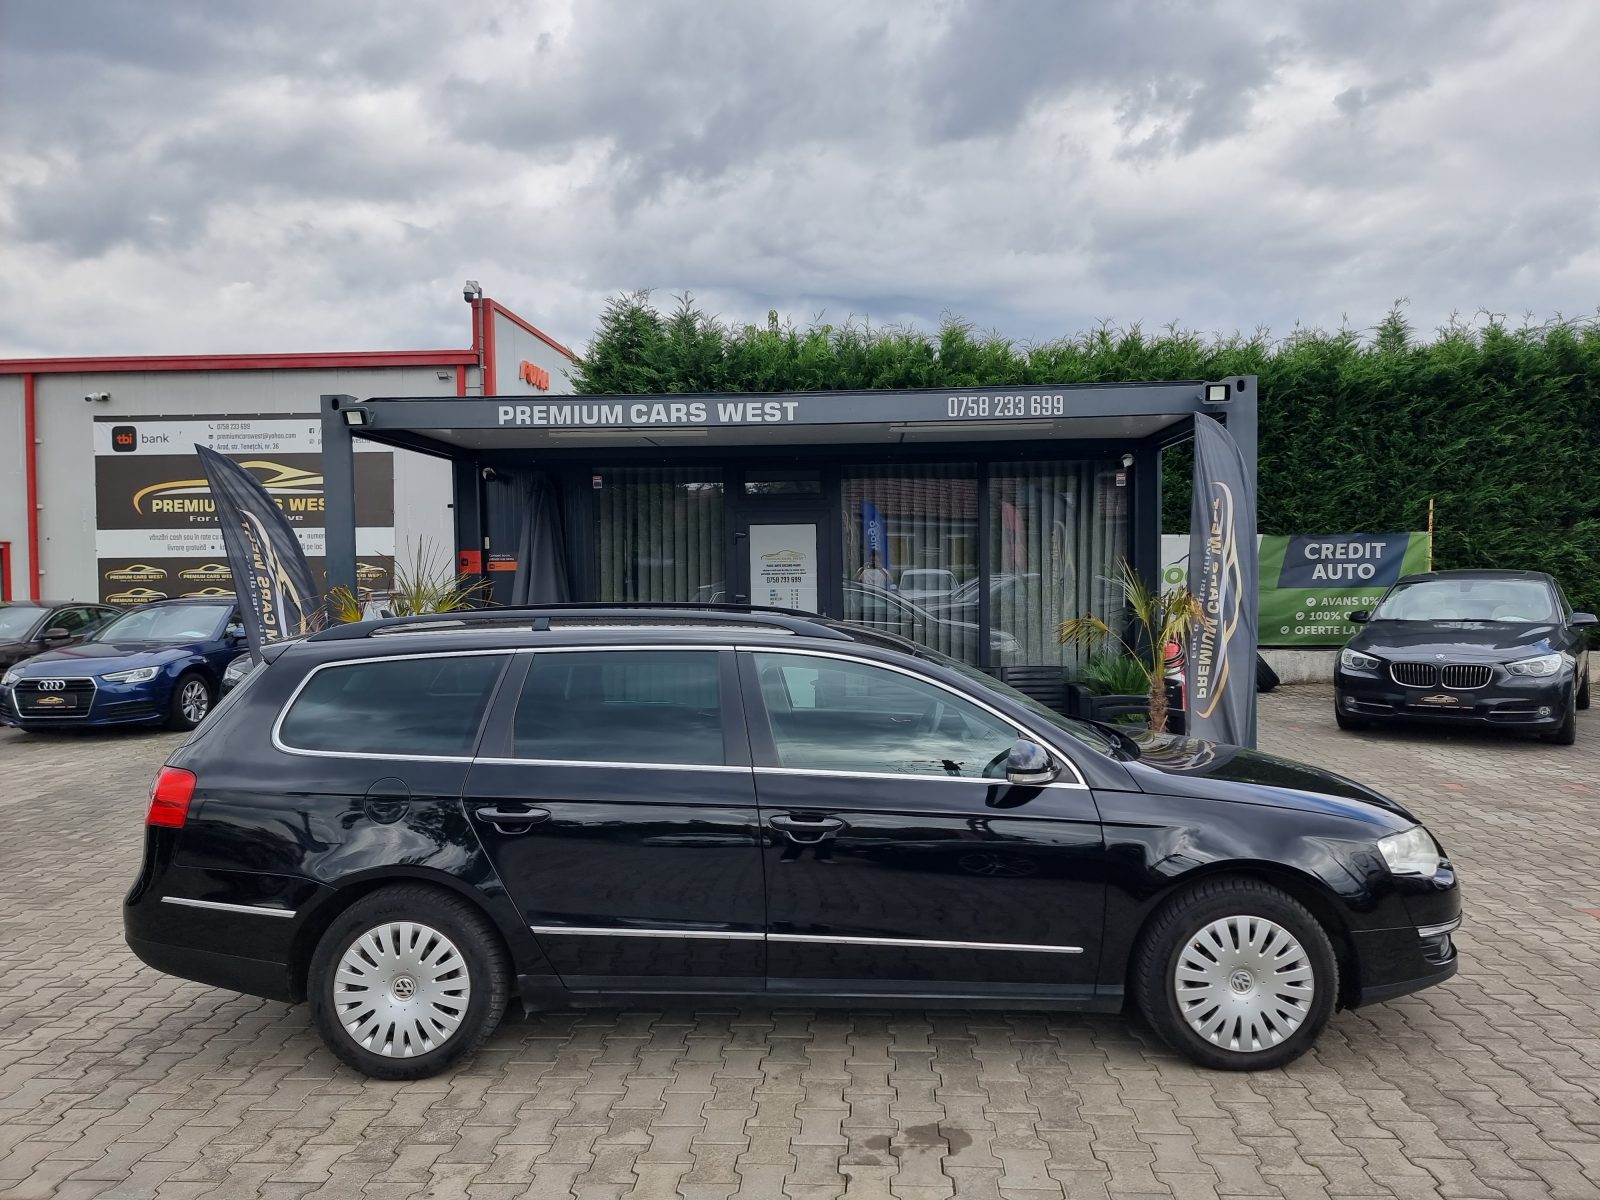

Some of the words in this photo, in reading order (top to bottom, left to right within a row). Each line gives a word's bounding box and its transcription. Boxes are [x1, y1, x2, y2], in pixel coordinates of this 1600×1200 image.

[948, 397, 989, 417] 0758
[994, 396, 1025, 416] 233
[1030, 395, 1064, 416] 699
[498, 405, 623, 425] PREMIUM
[630, 403, 707, 423] CARS
[717, 401, 799, 422] WEST
[116, 433, 132, 445] tbi
[141, 433, 170, 443] bank
[152, 499, 216, 513] PREMIU
[289, 498, 325, 511] WES
[1304, 543, 1386, 560] CREDIT
[1311, 563, 1376, 580] AUTO
[1321, 597, 1359, 606] AVANS
[1309, 612, 1340, 620] 100%
[1295, 626, 1340, 635] OFERTE
[1343, 626, 1356, 634] LA
